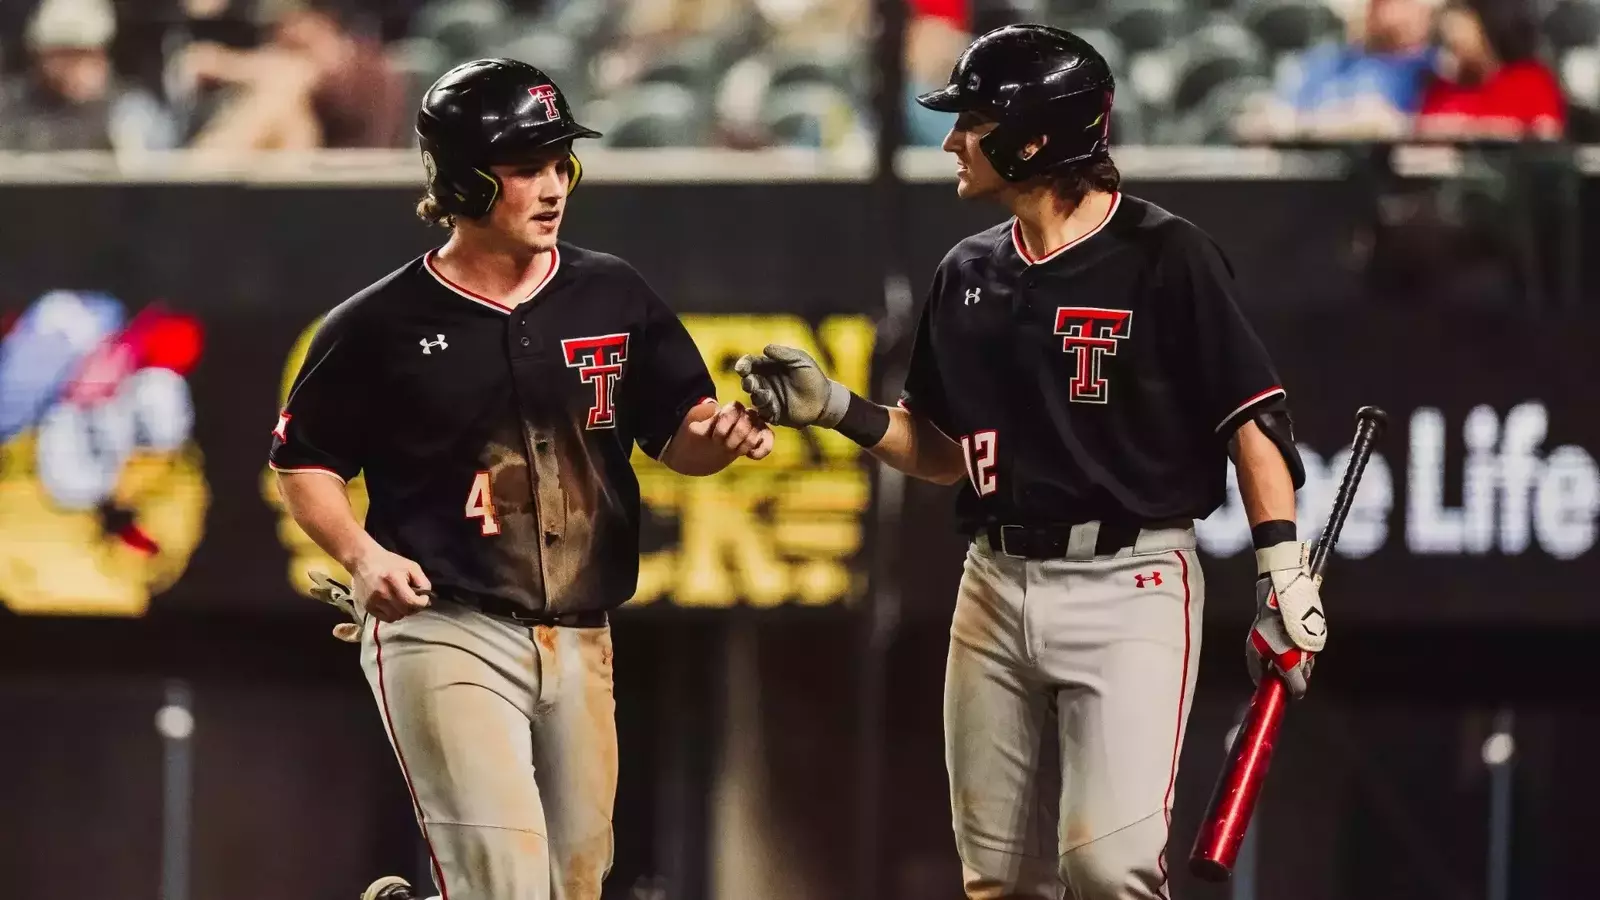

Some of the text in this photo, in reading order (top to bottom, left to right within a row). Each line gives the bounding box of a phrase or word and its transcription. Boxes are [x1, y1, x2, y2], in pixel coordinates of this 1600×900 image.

[961, 429, 998, 499] 12
[1405, 399, 1600, 560] Life
[464, 468, 501, 537] 4
